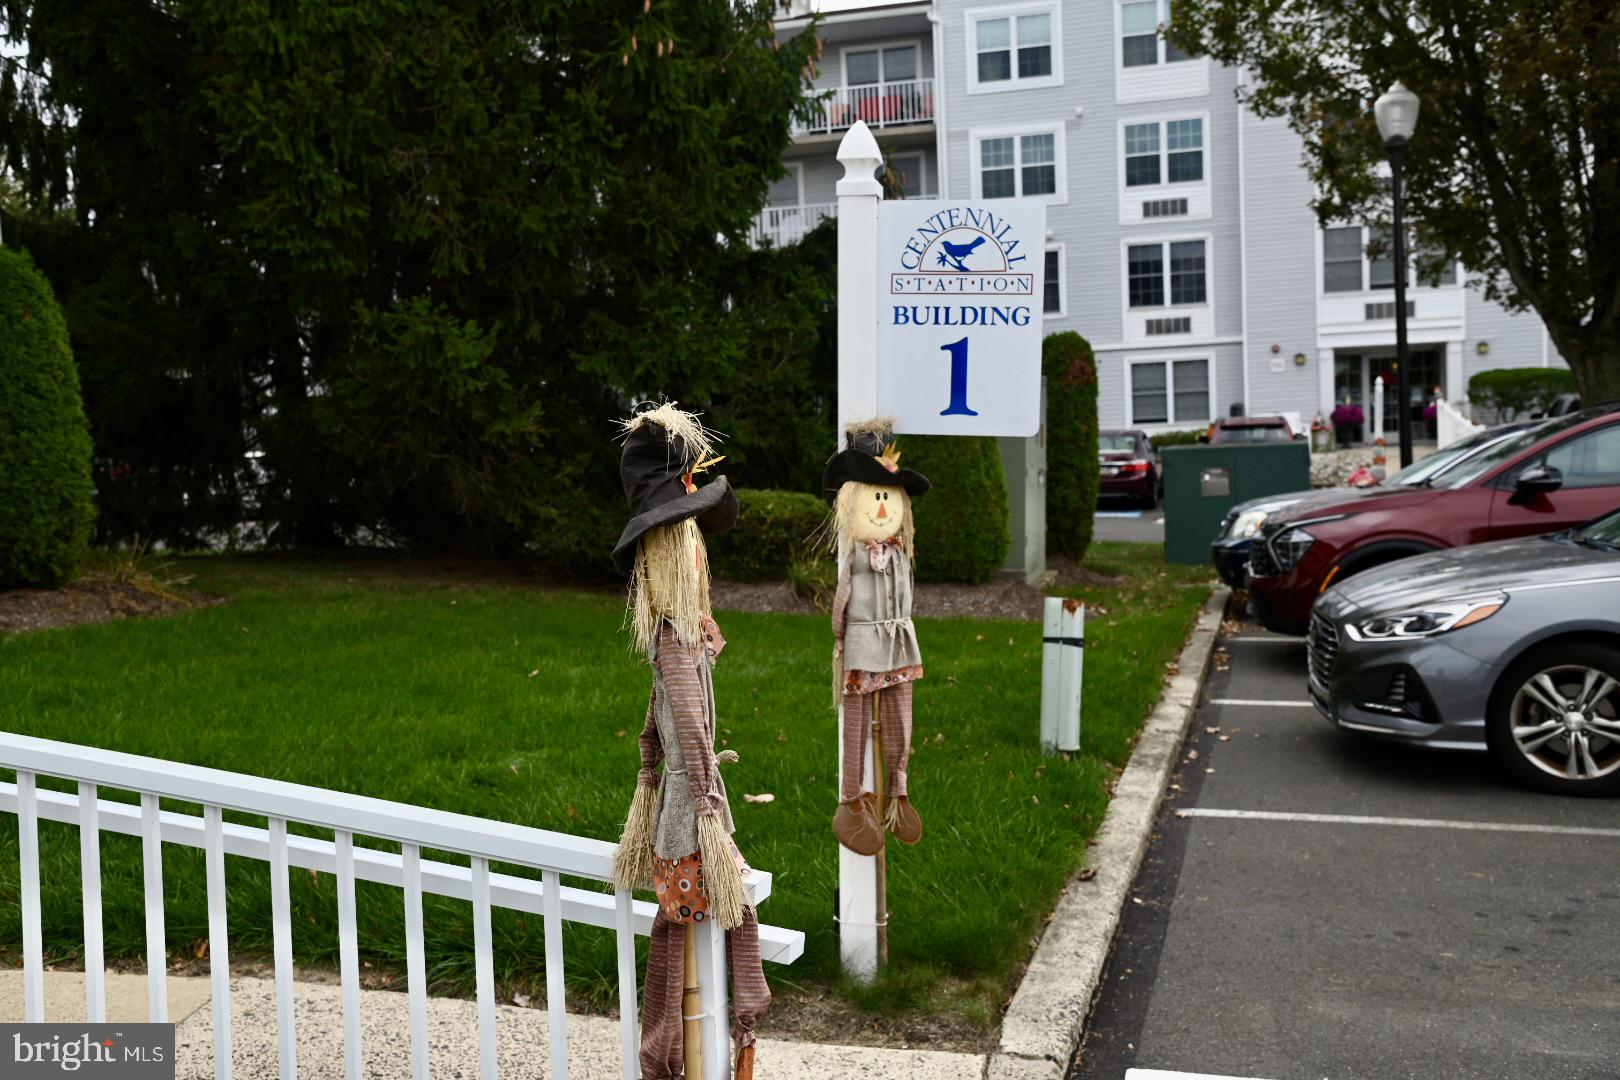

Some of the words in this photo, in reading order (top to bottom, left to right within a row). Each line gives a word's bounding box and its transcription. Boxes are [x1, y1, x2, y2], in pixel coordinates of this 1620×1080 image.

[901, 207, 1026, 270] CENTENNIAL
[892, 305, 1031, 326] BUILDING
[939, 336, 979, 417] 1
